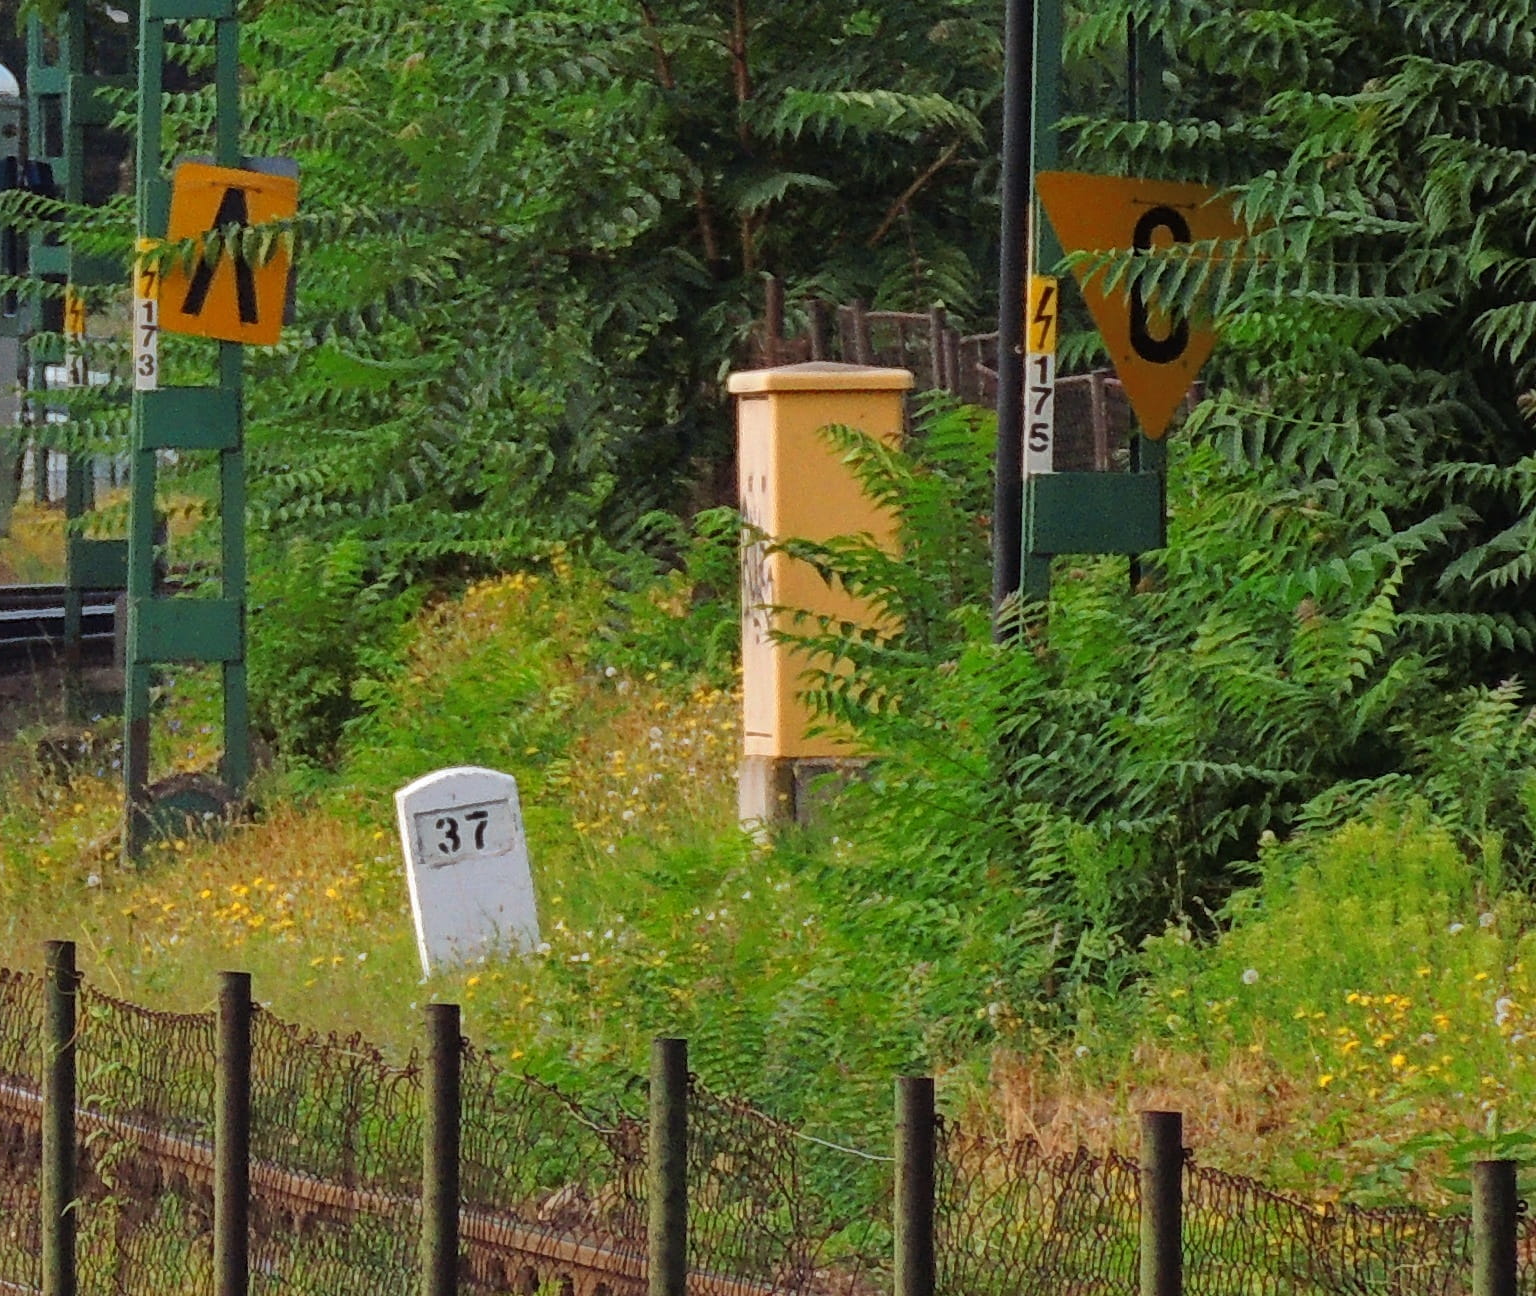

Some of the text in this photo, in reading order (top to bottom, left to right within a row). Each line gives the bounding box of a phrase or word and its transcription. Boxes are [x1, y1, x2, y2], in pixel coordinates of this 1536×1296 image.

[138, 300, 159, 377] 173
[1029, 355, 1053, 453] 175
[436, 810, 489, 853] 37
